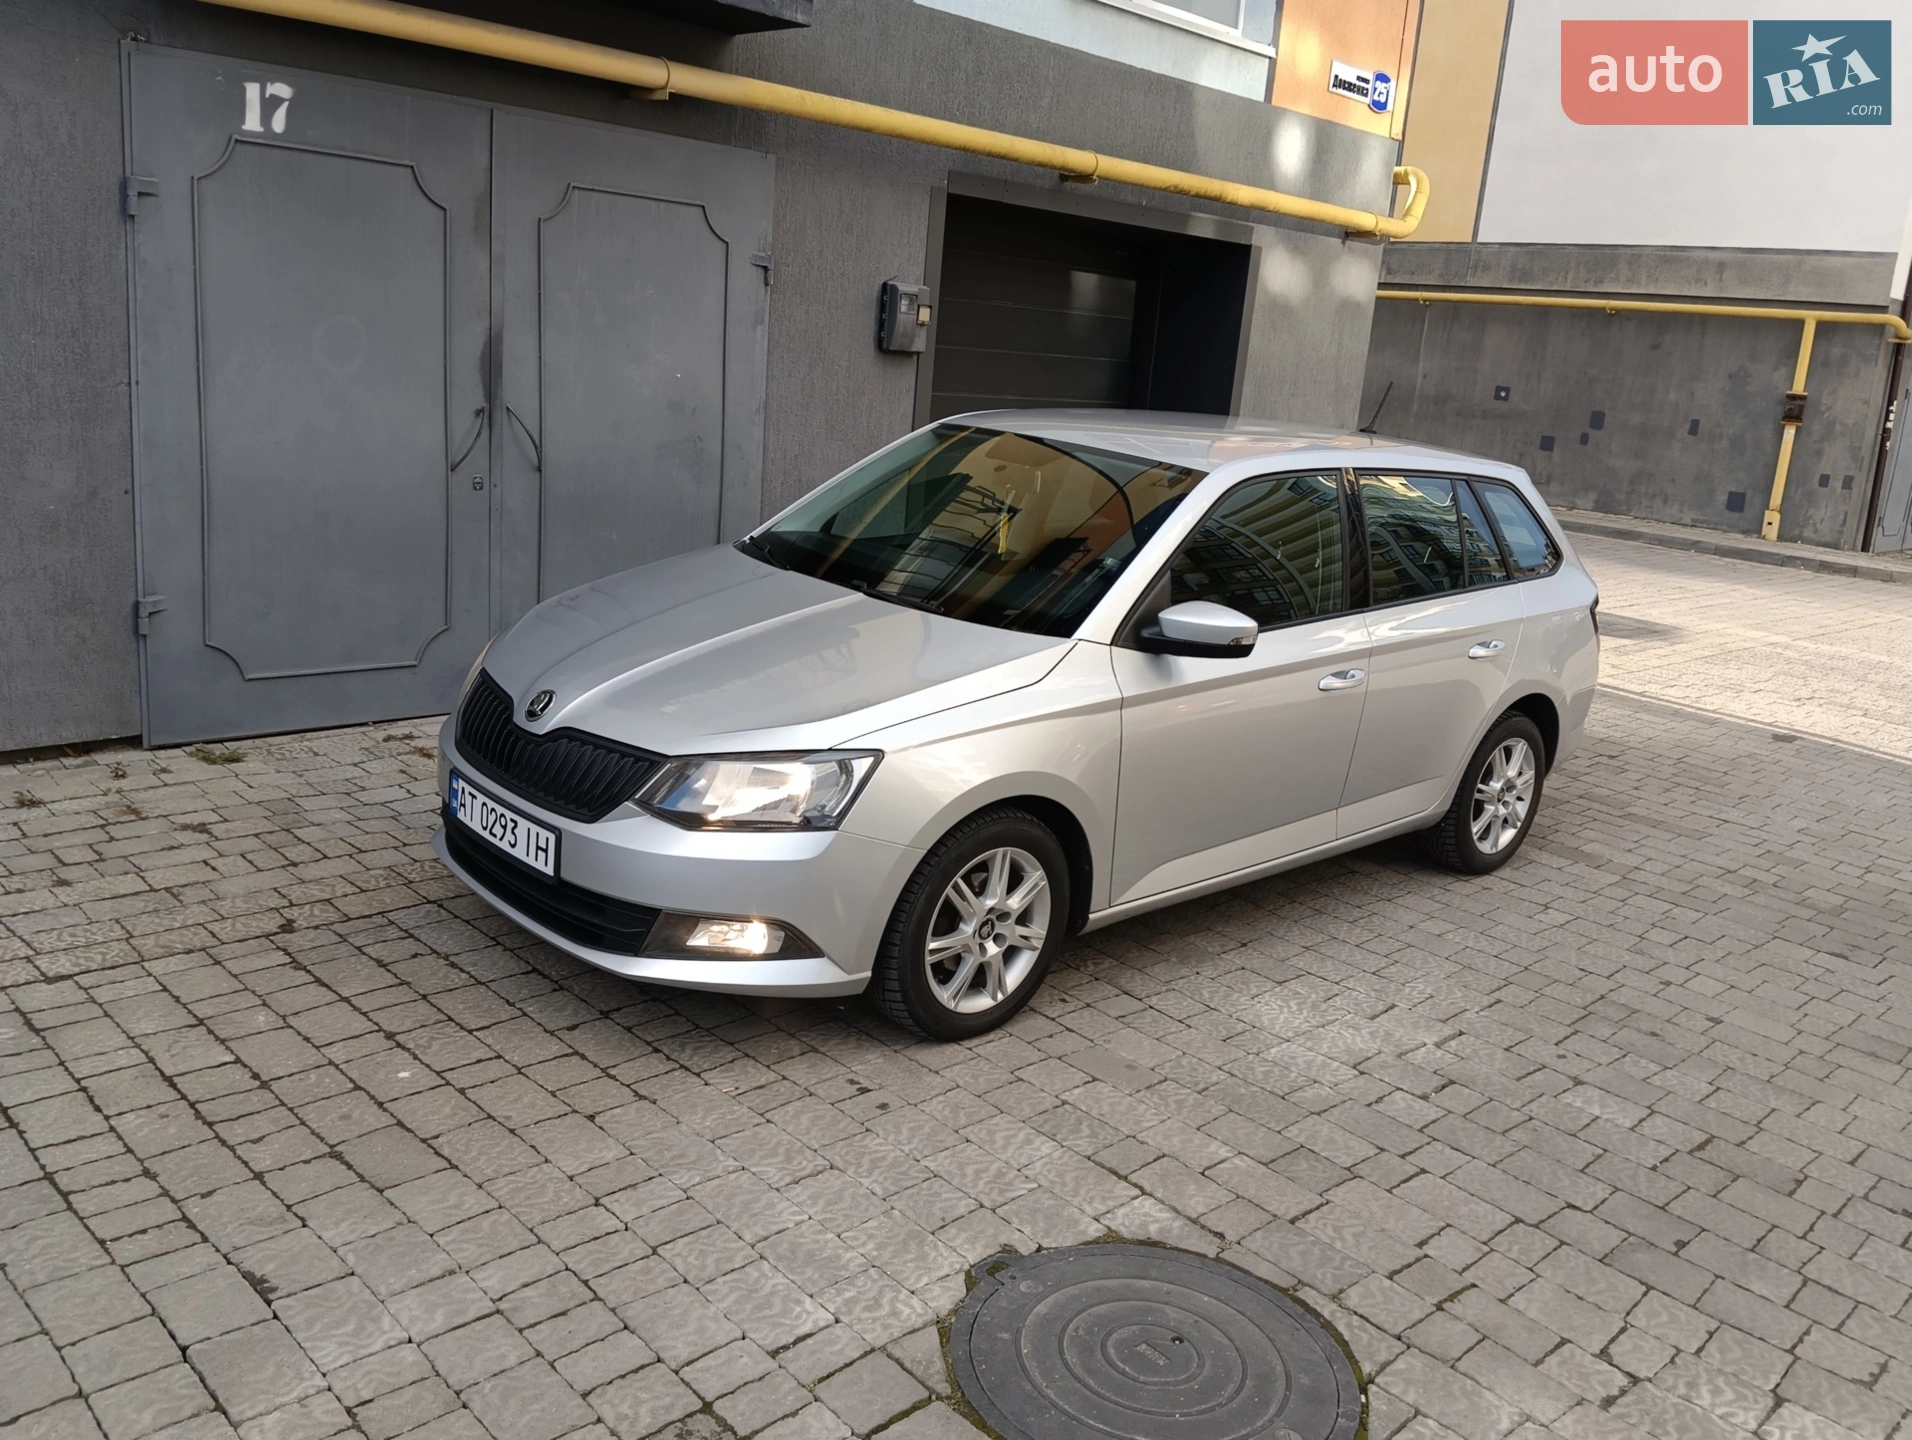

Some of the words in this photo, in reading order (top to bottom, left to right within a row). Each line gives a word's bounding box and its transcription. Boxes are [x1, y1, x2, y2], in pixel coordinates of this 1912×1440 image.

[241, 82, 295, 134] 17
[1373, 80, 1390, 103] 25
[458, 786, 478, 823] AT
[480, 801, 519, 849] 0293
[526, 827, 550, 867] IH
